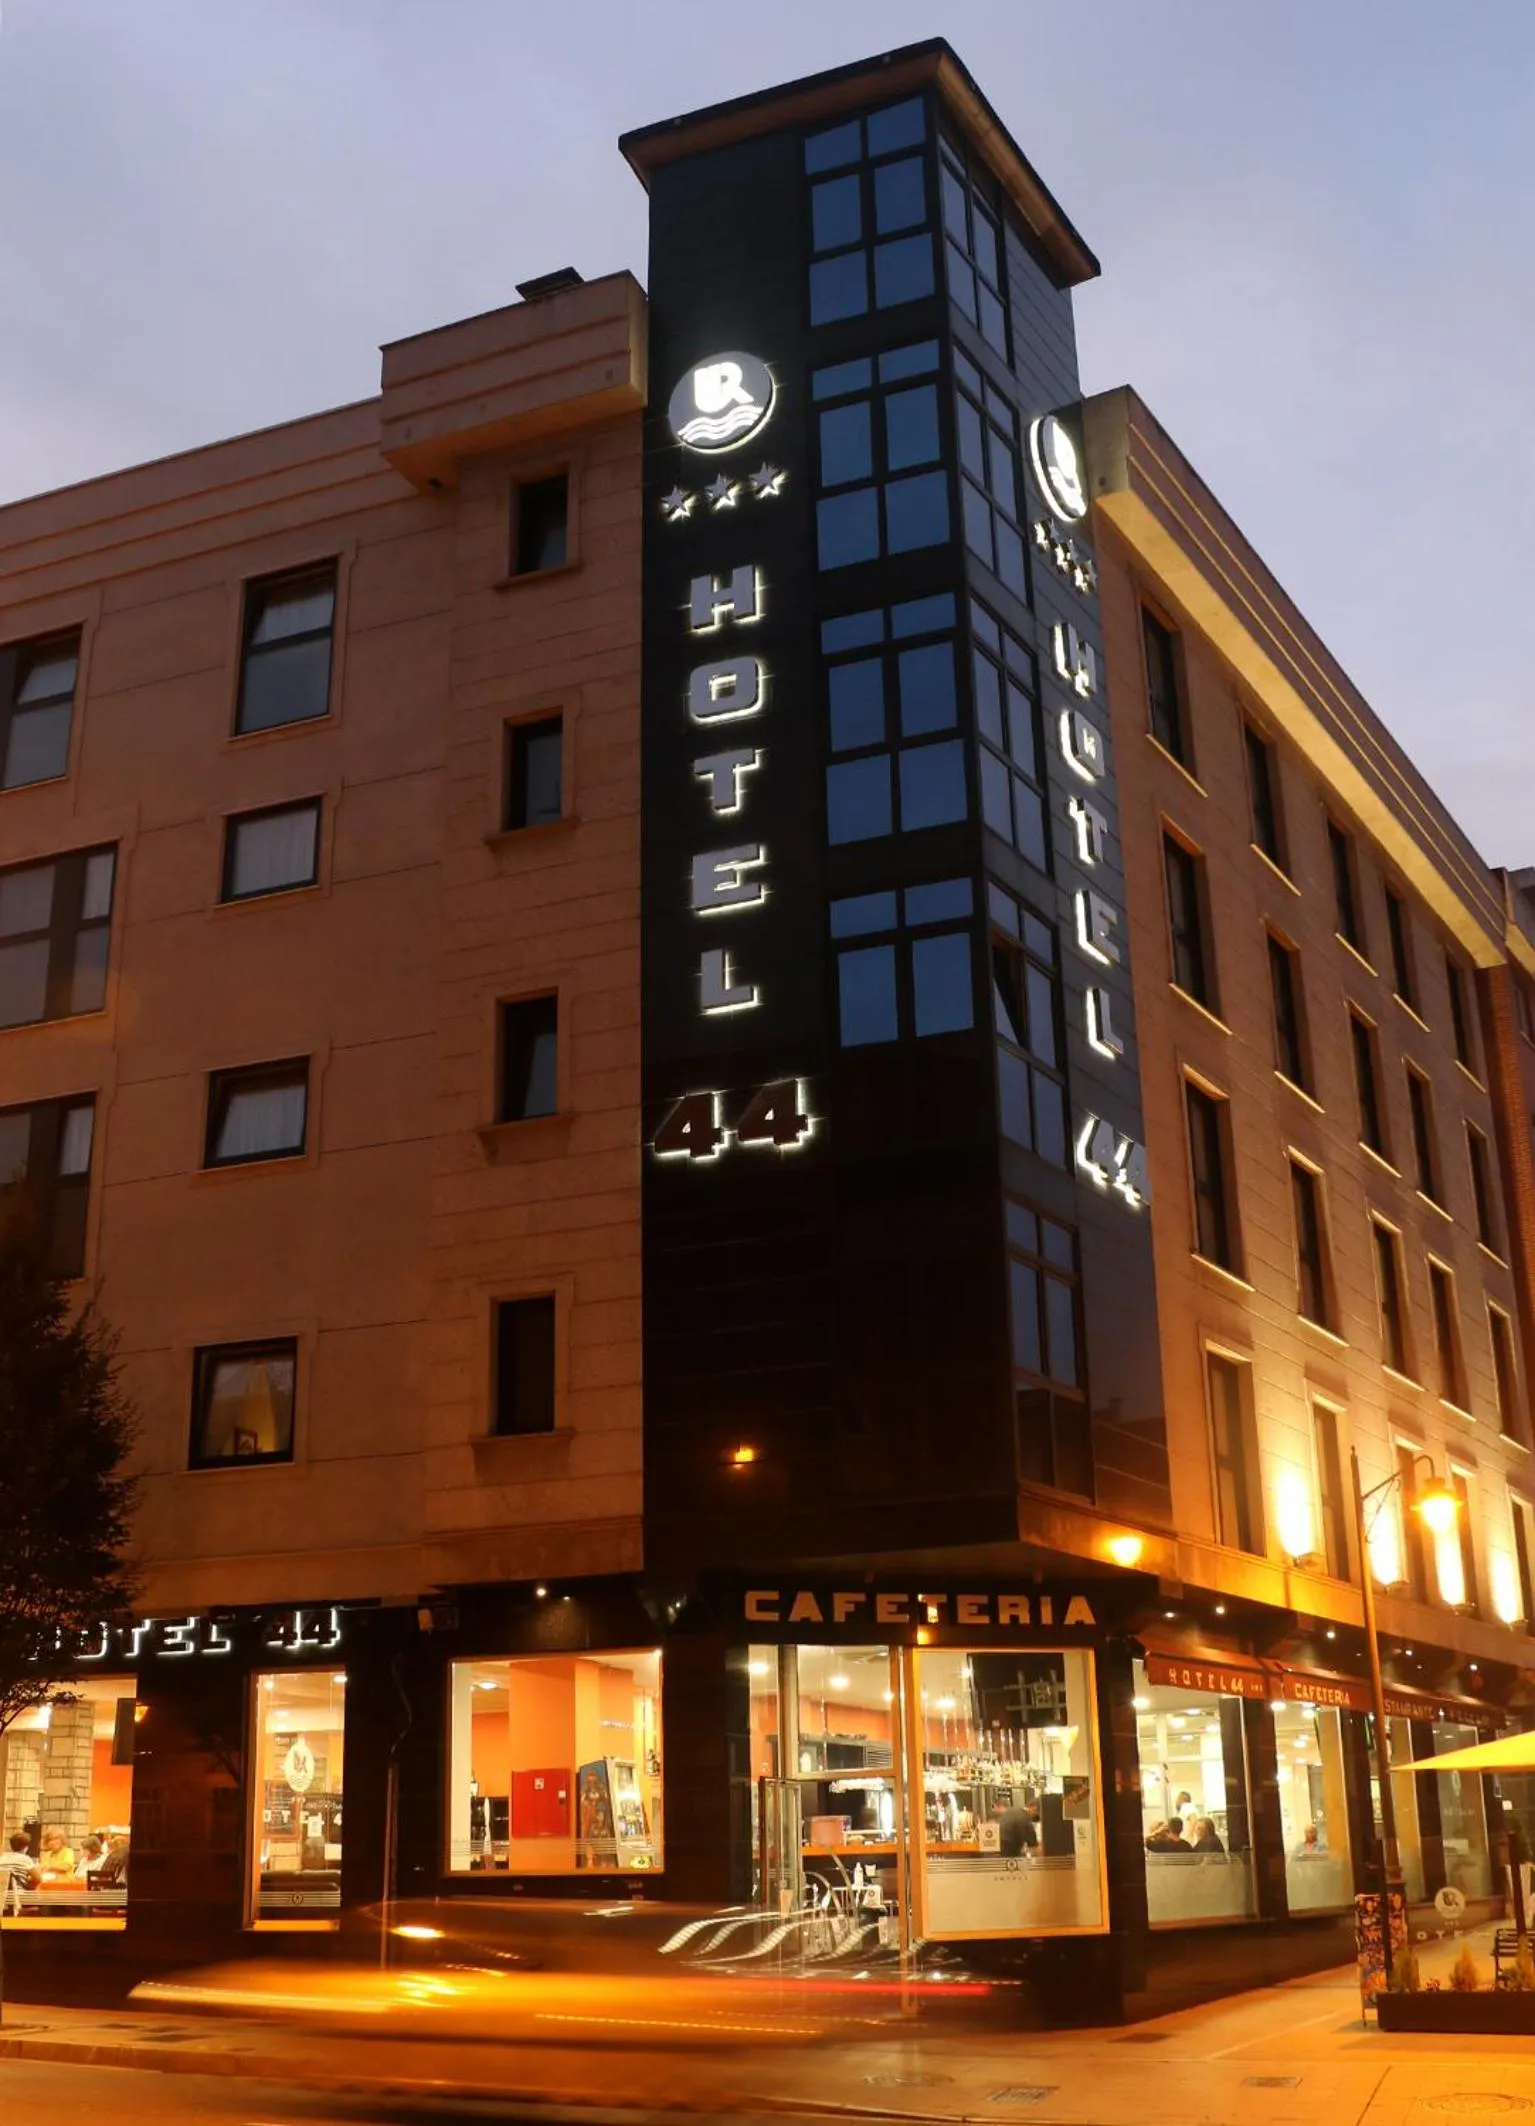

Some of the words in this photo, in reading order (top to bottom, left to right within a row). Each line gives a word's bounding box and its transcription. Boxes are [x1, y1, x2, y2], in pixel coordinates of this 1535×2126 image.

[687, 564, 768, 1016] HOTEL
[1052, 622, 1123, 1058] HOTEL
[652, 1077, 814, 1160] 44
[1077, 1114, 1149, 1208] 44
[266, 1607, 341, 1649] 44
[745, 1590, 1097, 1625] CAFETERIA
[1168, 1667, 1227, 1692] HOTEL
[1294, 1681, 1350, 1705] CAFETERIA
[1384, 1698, 1434, 1720] STAURANTE
